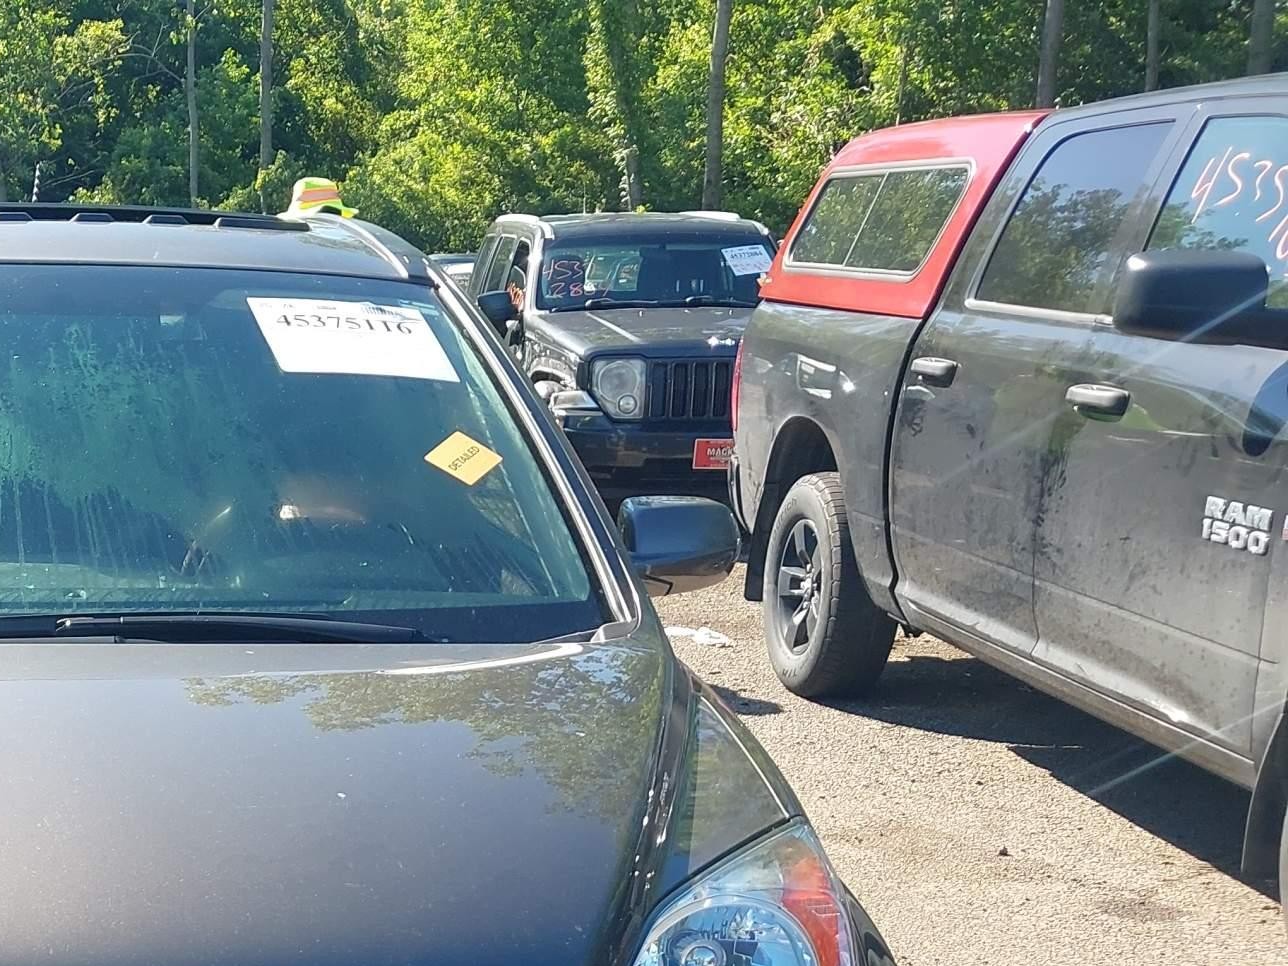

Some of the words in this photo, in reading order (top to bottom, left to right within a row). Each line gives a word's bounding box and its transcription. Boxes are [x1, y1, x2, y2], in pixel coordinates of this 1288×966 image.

[276, 314, 412, 335] 45375116
[447, 446, 480, 471] DETAILED
[1204, 495, 1274, 531] RAM
[1202, 518, 1271, 555] 1500
